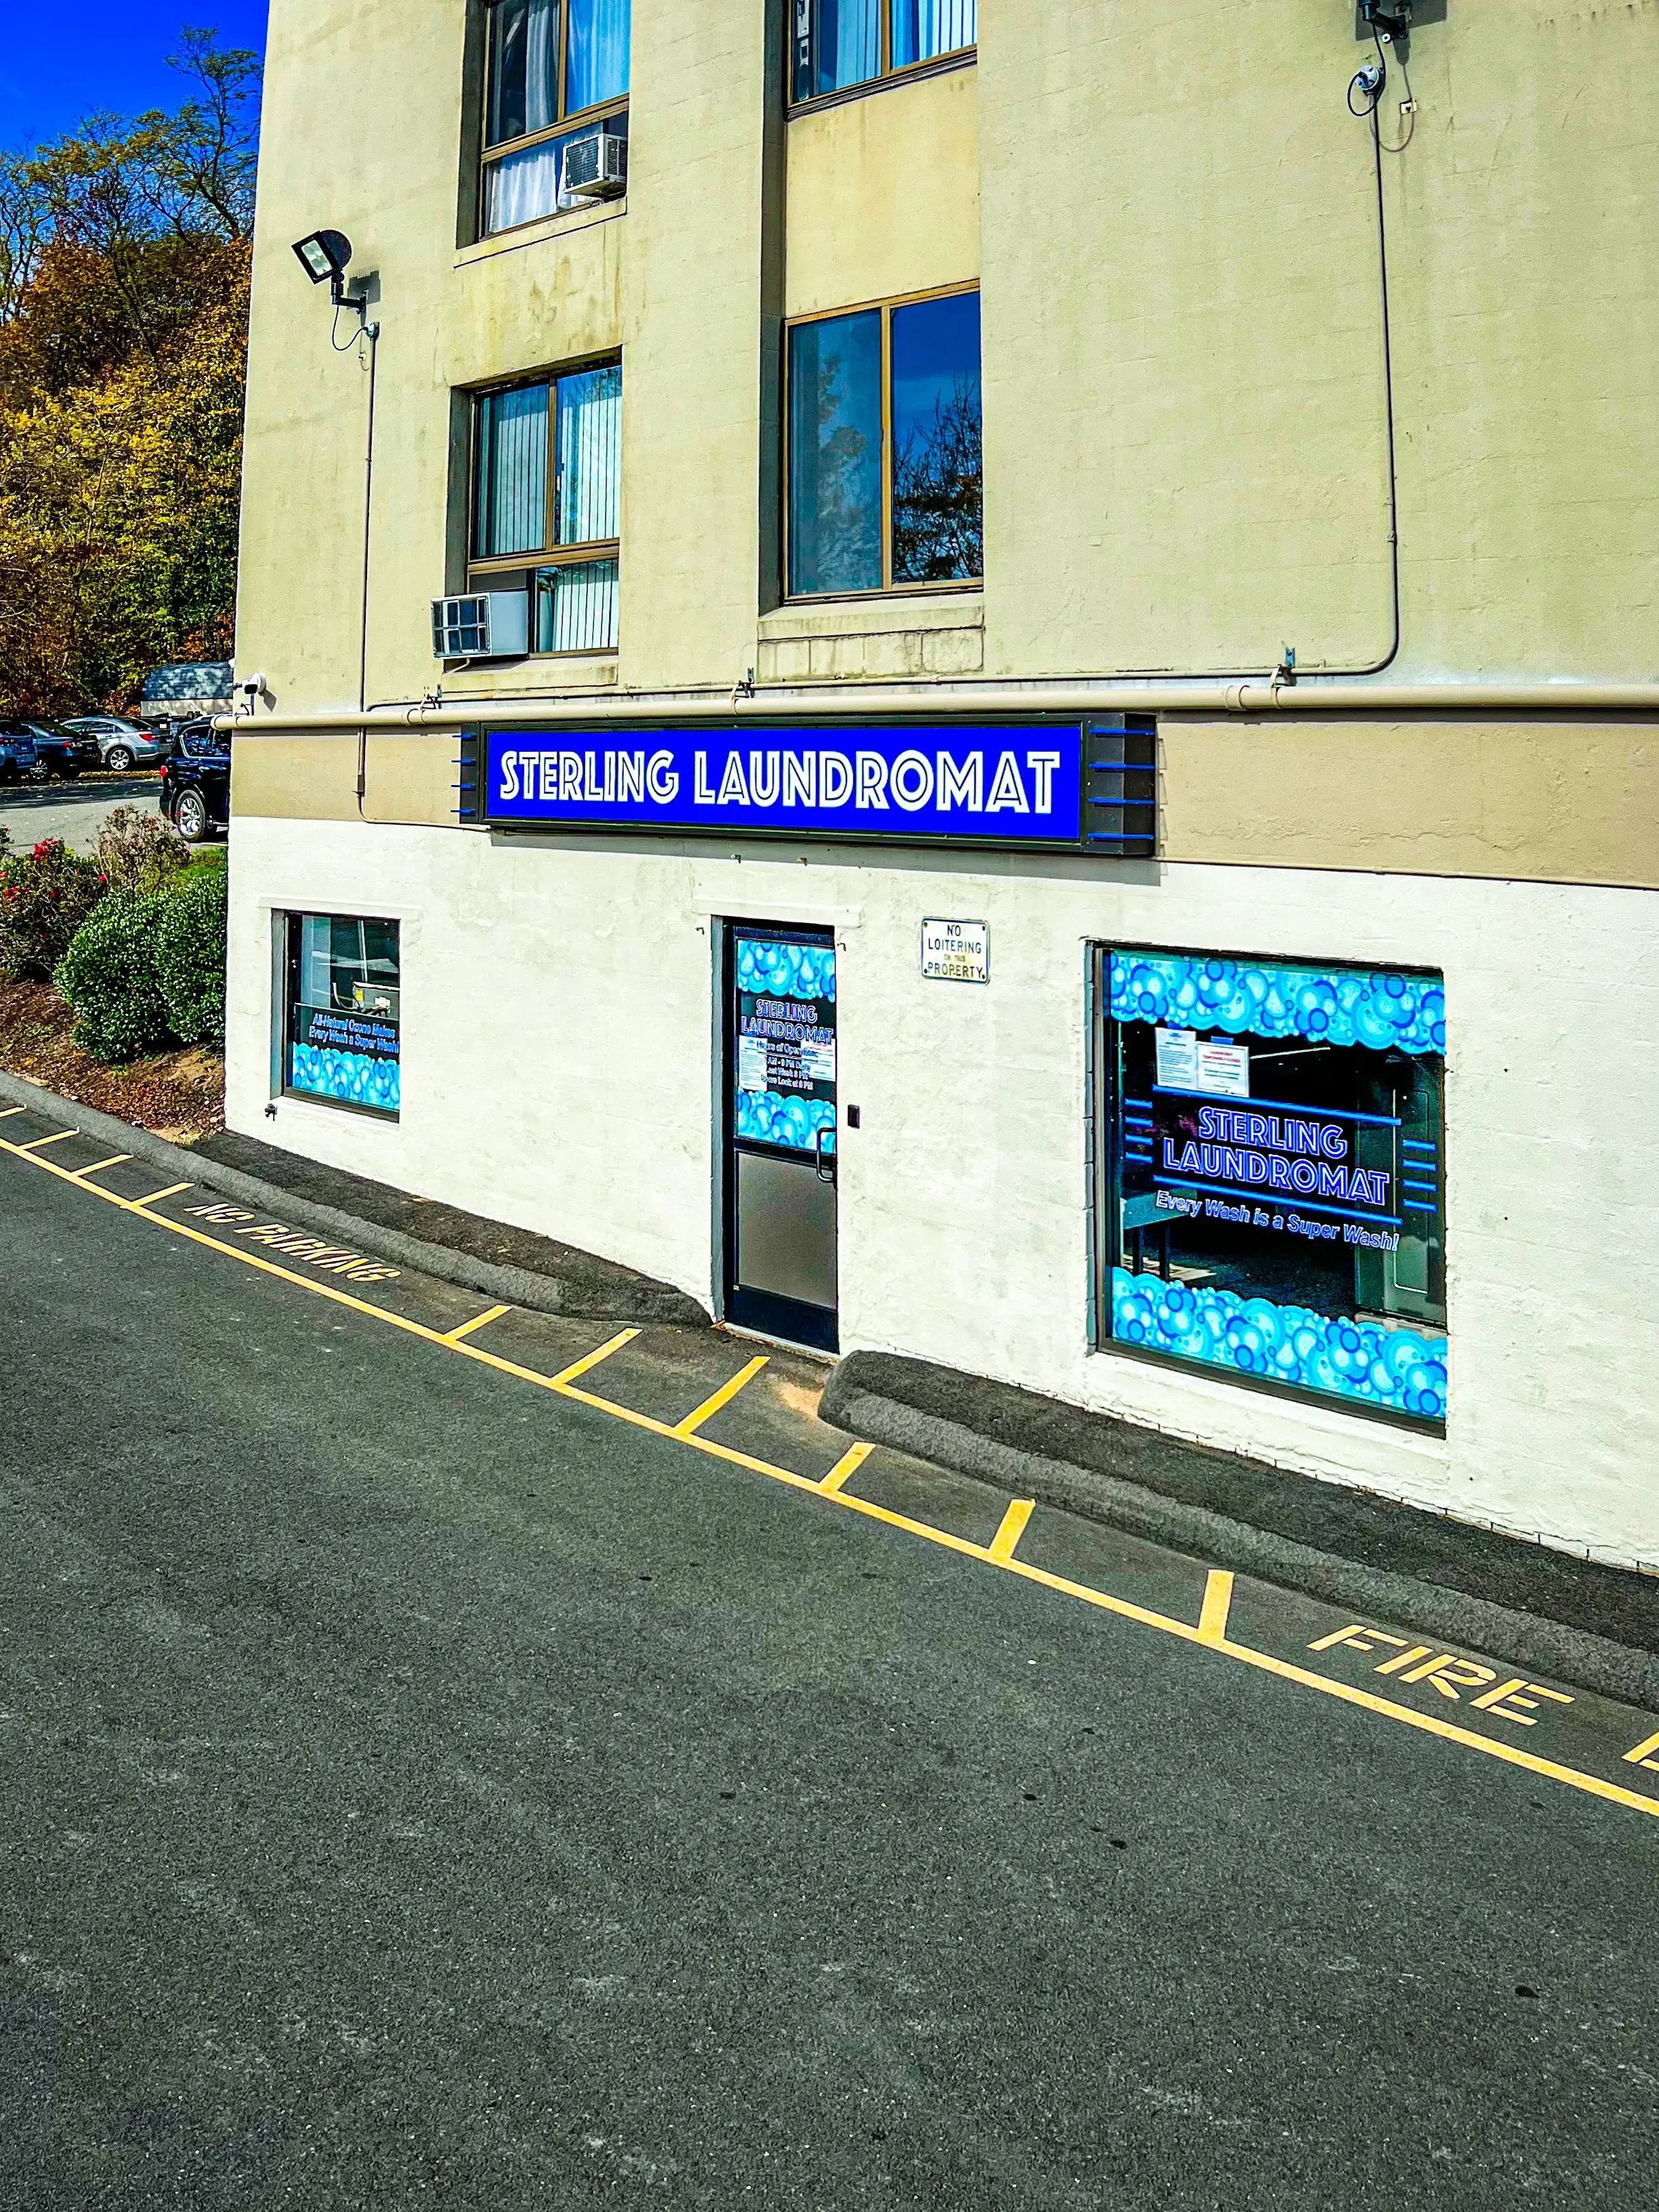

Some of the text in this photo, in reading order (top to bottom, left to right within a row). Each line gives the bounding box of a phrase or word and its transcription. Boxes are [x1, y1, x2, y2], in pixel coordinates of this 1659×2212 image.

[500, 748, 1061, 815] STERLING LAUNDROMAT
[947, 924, 962, 937] NO
[928, 937, 982, 954] LOITERING
[928, 962, 983, 979] PROPERTY
[756, 998, 818, 1024] STERLING
[308, 1025, 328, 1043] Every
[328, 1028, 348, 1044] Wash
[349, 1035, 354, 1045] a
[354, 1034, 376, 1050] Super
[741, 1015, 834, 1045] LAUNDROMAT
[756, 1040, 775, 1051] Hours
[775, 1042, 784, 1052] of
[803, 1080, 814, 1090] PM
[1198, 1105, 1348, 1160] STERLING
[1163, 1137, 1390, 1206] LAUNDROMAT
[1155, 1189, 1400, 1252] Every Wash is a Super Wash!
[183, 1202, 402, 1282] NO PARKING
[1306, 1623, 1576, 1727] FIRE
